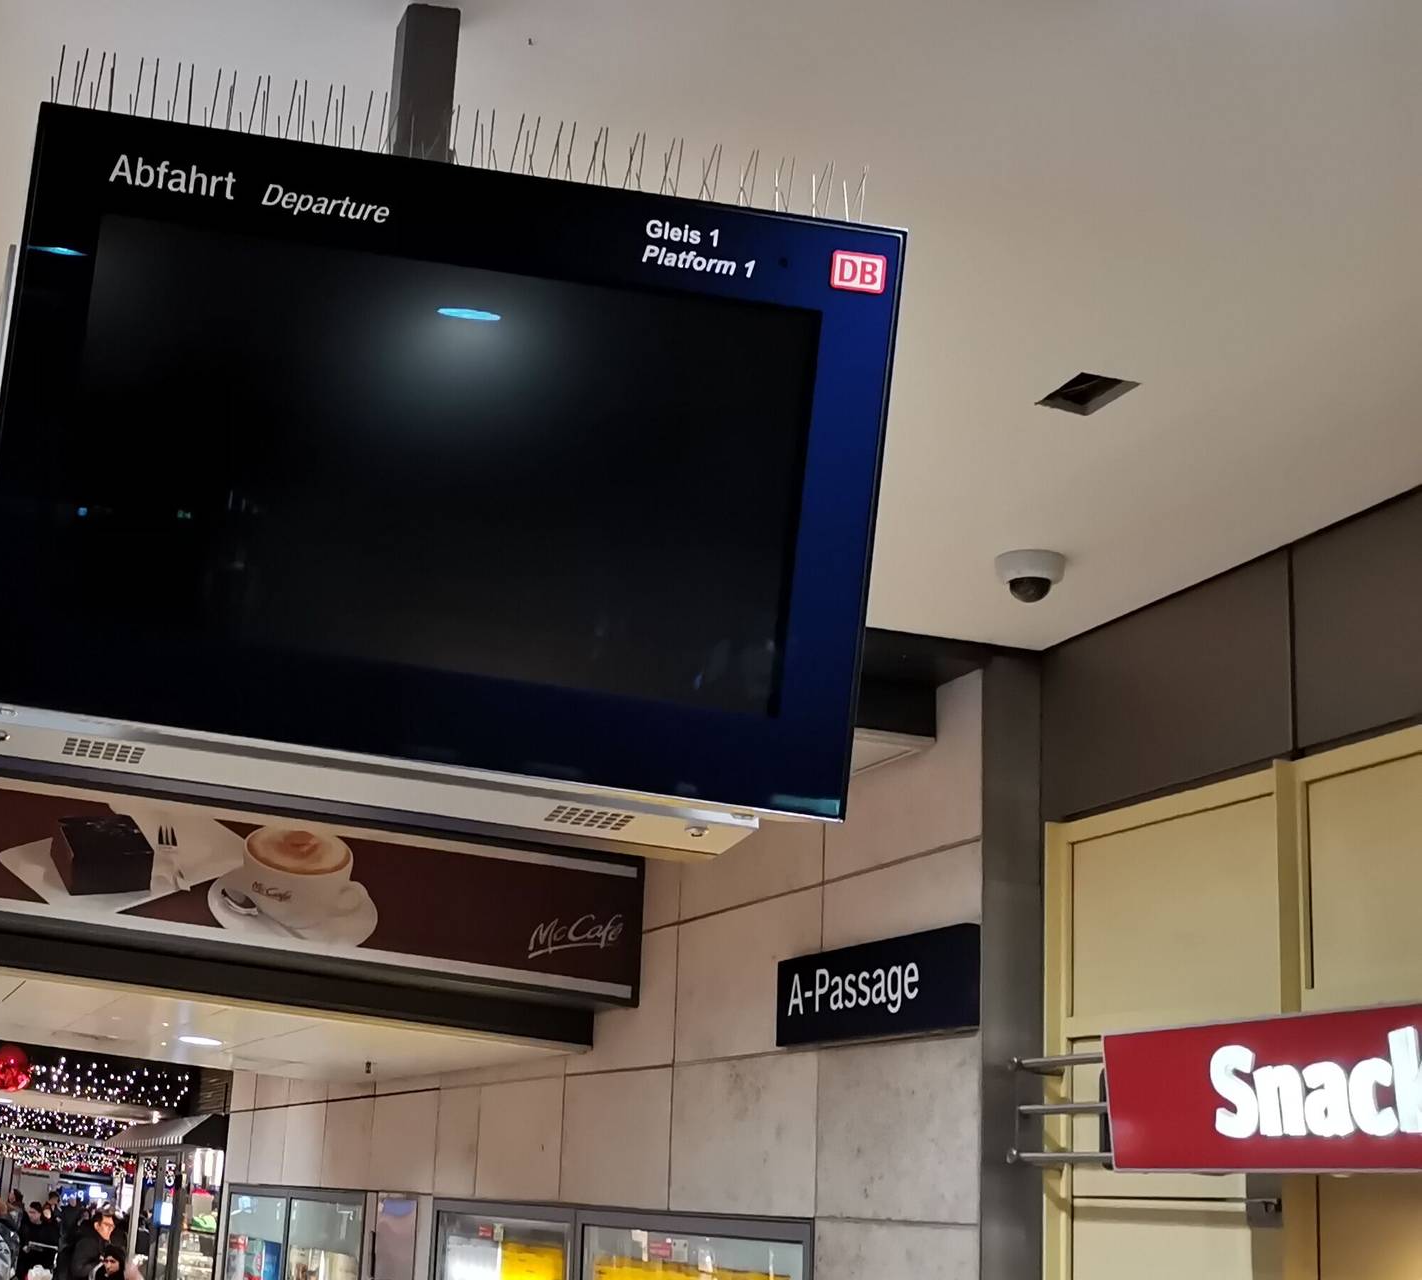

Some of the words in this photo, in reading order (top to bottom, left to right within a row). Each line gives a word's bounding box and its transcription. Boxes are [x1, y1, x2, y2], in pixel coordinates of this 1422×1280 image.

[108, 153, 237, 201] Abfahrt
[261, 182, 391, 224] Departure
[645, 218, 702, 245] Gleis
[708, 228, 720, 248] 1
[641, 244, 738, 277] Platform
[743, 259, 757, 279] 1
[837, 257, 879, 286] DB
[787, 961, 920, 1014] A-Passage
